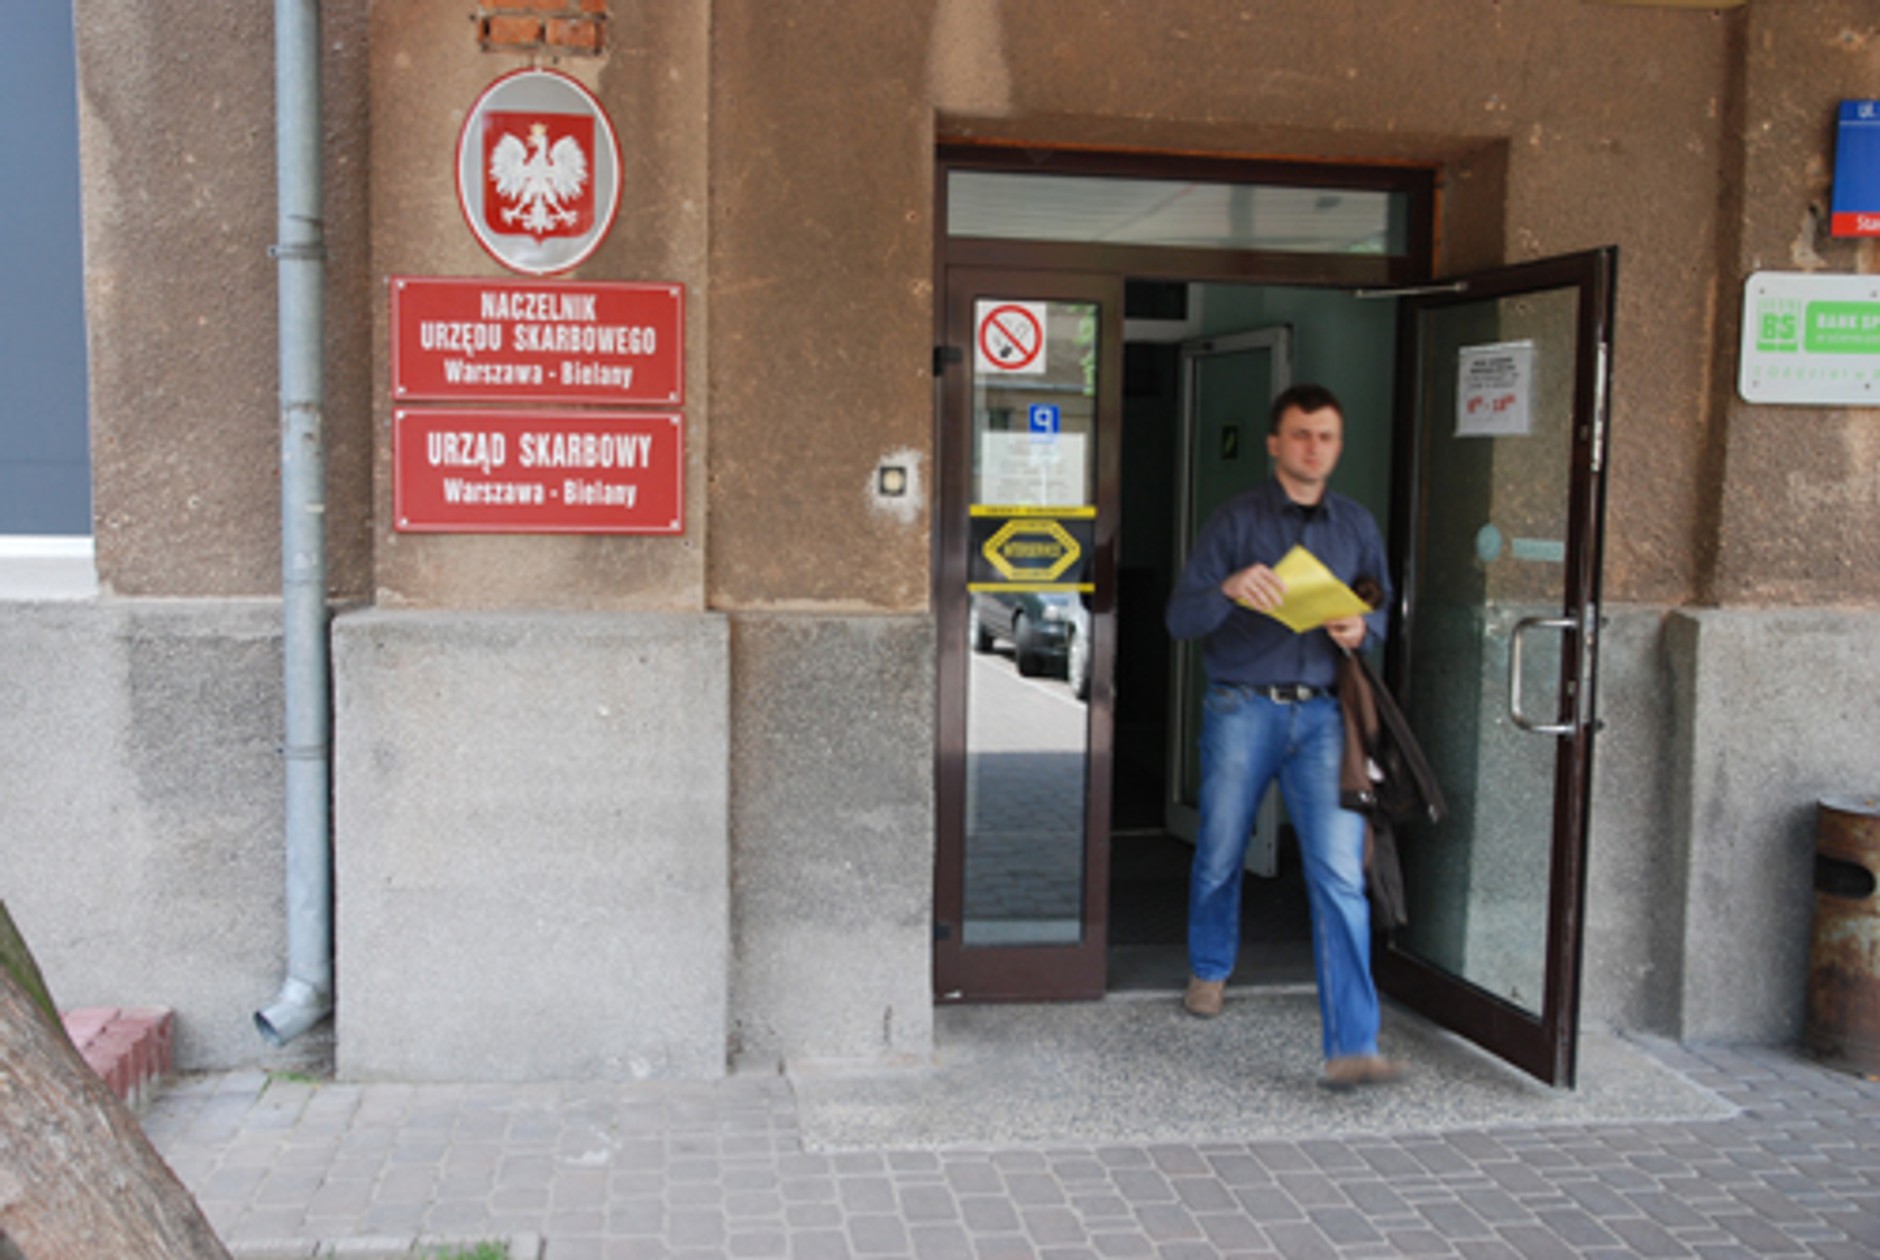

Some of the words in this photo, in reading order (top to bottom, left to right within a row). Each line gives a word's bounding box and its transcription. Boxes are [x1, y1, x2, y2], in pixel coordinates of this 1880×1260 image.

[481, 293, 596, 320] NACZELNIK
[421, 322, 502, 357] URZĘDU
[513, 324, 657, 355] SKARBOWEGO
[1762, 313, 1796, 340] BS
[444, 358, 543, 385] Warszawa
[561, 361, 634, 389] Bielany
[428, 432, 505, 474] URZĄD
[518, 432, 652, 468] SKARBOWY
[443, 477, 545, 504] Warszawa
[563, 480, 637, 508] Bielany
